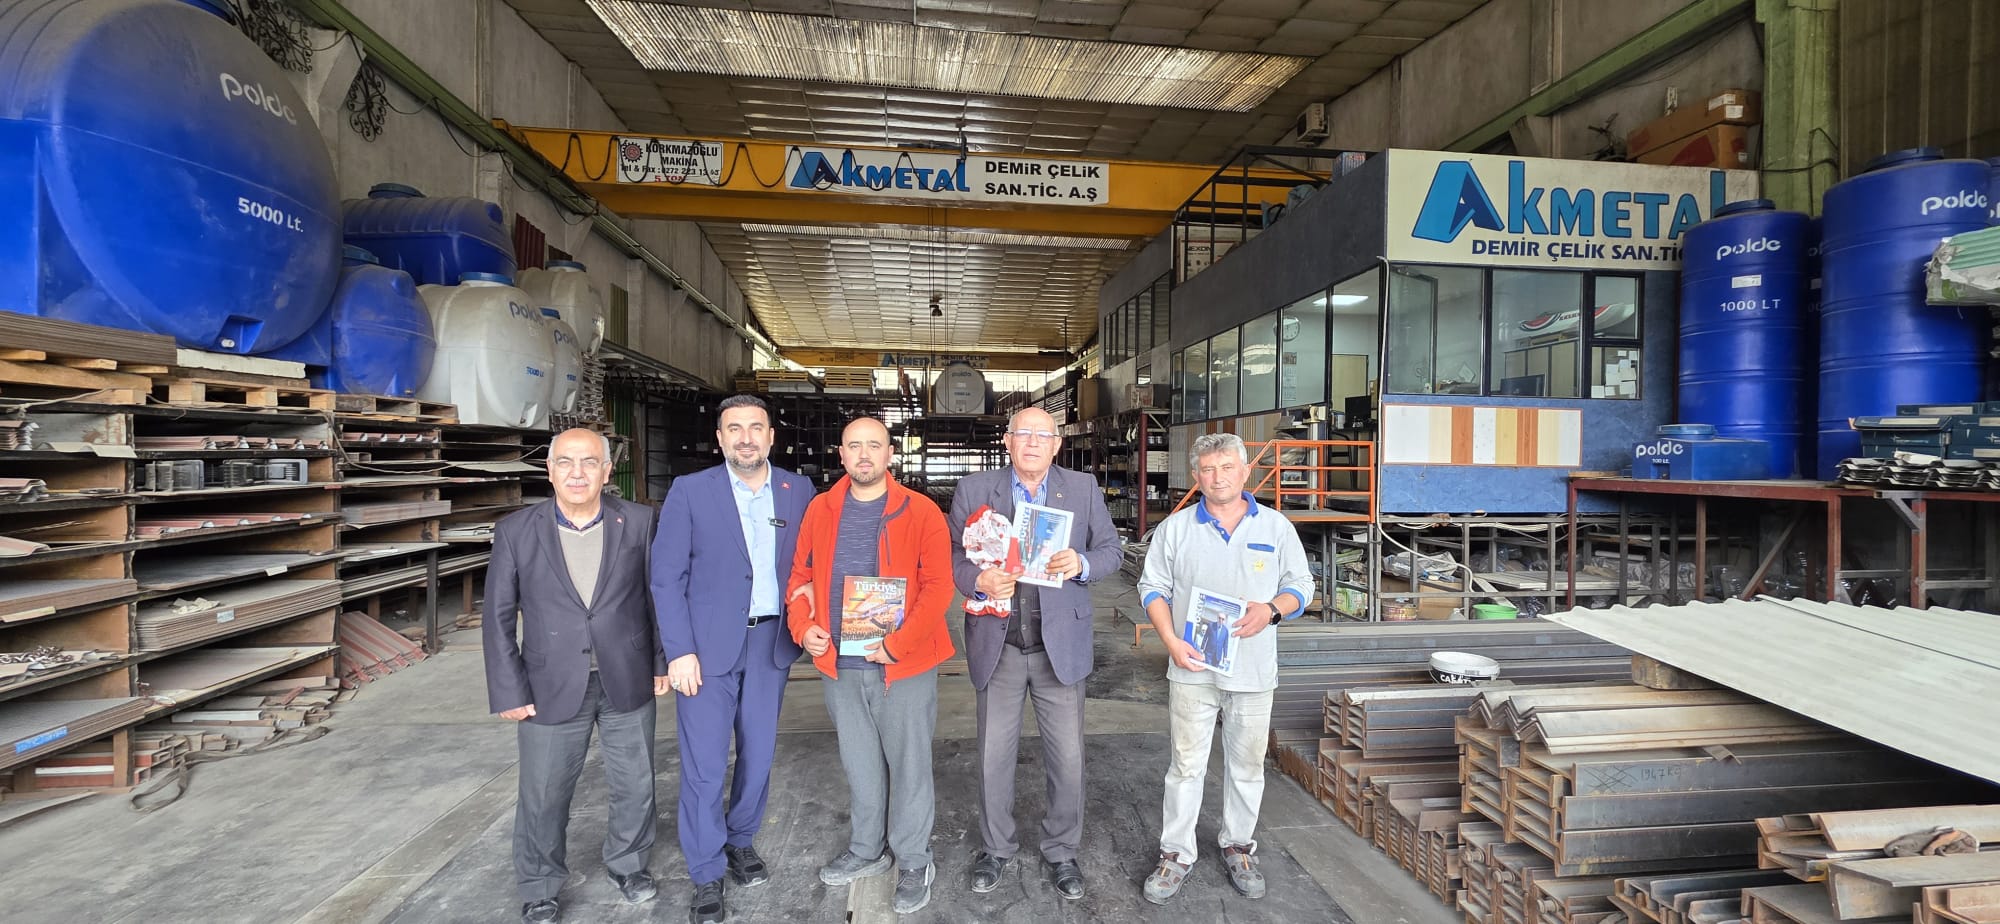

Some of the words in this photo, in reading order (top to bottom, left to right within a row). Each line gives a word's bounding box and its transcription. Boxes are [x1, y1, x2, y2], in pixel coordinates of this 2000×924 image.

[655, 175, 662, 183] 5
[1921, 190, 1988, 215] polde
[238, 197, 283, 226] 5000
[287, 214, 304, 233] Lt.
[1472, 237, 1540, 257] DEMİR
[1548, 239, 1608, 263] ÇELİK
[1716, 237, 1782, 261] polde
[1720, 300, 1756, 312] 1000
[1636, 441, 1684, 458] polde
[854, 581, 897, 593] Türkiye
